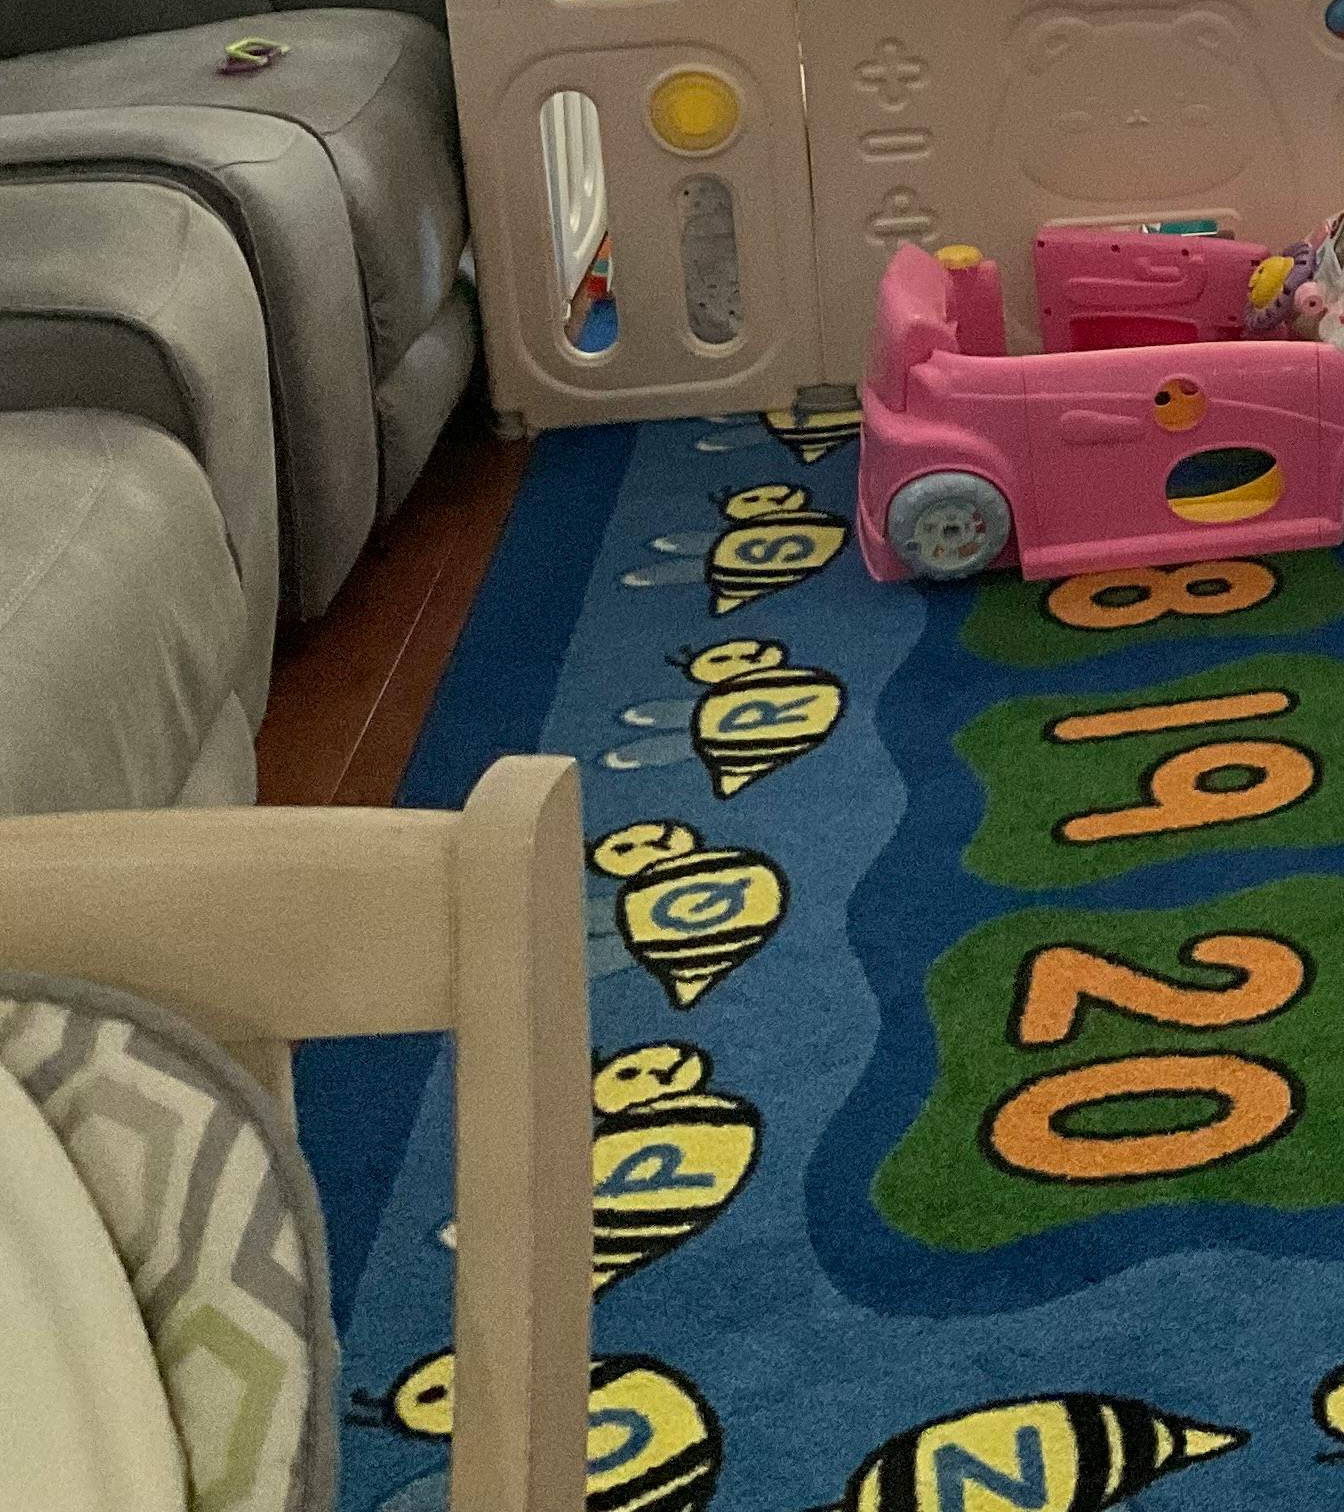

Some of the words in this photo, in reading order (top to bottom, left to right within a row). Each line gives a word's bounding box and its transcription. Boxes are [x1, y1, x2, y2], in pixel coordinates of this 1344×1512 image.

[735, 535, 816, 564] S
[718, 701, 819, 732] R
[1048, 686, 1320, 847] 19
[651, 877, 753, 931] Q
[986, 929, 1309, 1185] 20
[593, 1144, 716, 1197] P
[933, 1425, 1049, 1512] N
